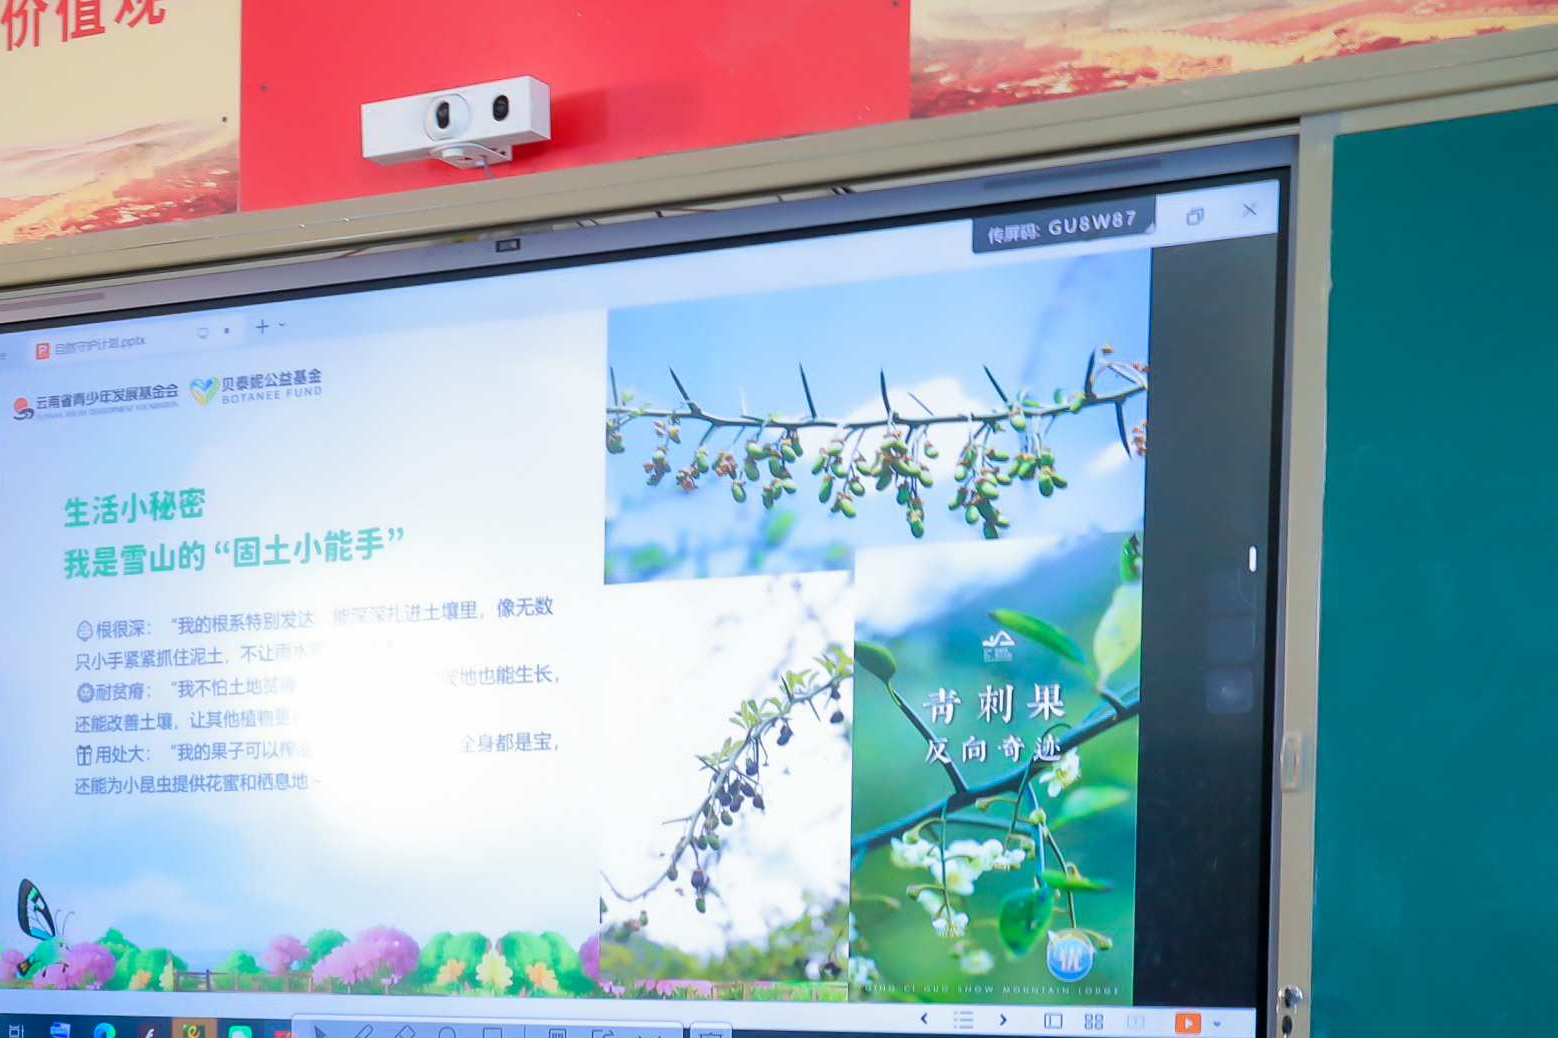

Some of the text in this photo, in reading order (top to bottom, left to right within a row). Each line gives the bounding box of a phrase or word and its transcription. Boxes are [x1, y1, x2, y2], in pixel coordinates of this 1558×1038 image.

[1048, 210, 1137, 236] GU8W87
[221, 368, 323, 393] 贝泰妮公益基金
[36, 383, 179, 411] 云南省青少年发展基金会
[222, 386, 323, 405] BOTANEE FUND
[63, 487, 205, 528] 生活小秘密
[922, 682, 1066, 725] 青刺果
[925, 734, 1062, 764] 反向奇迹
[958, 985, 994, 994] SNOW
[1003, 986, 1070, 996] MOUNTAIN
